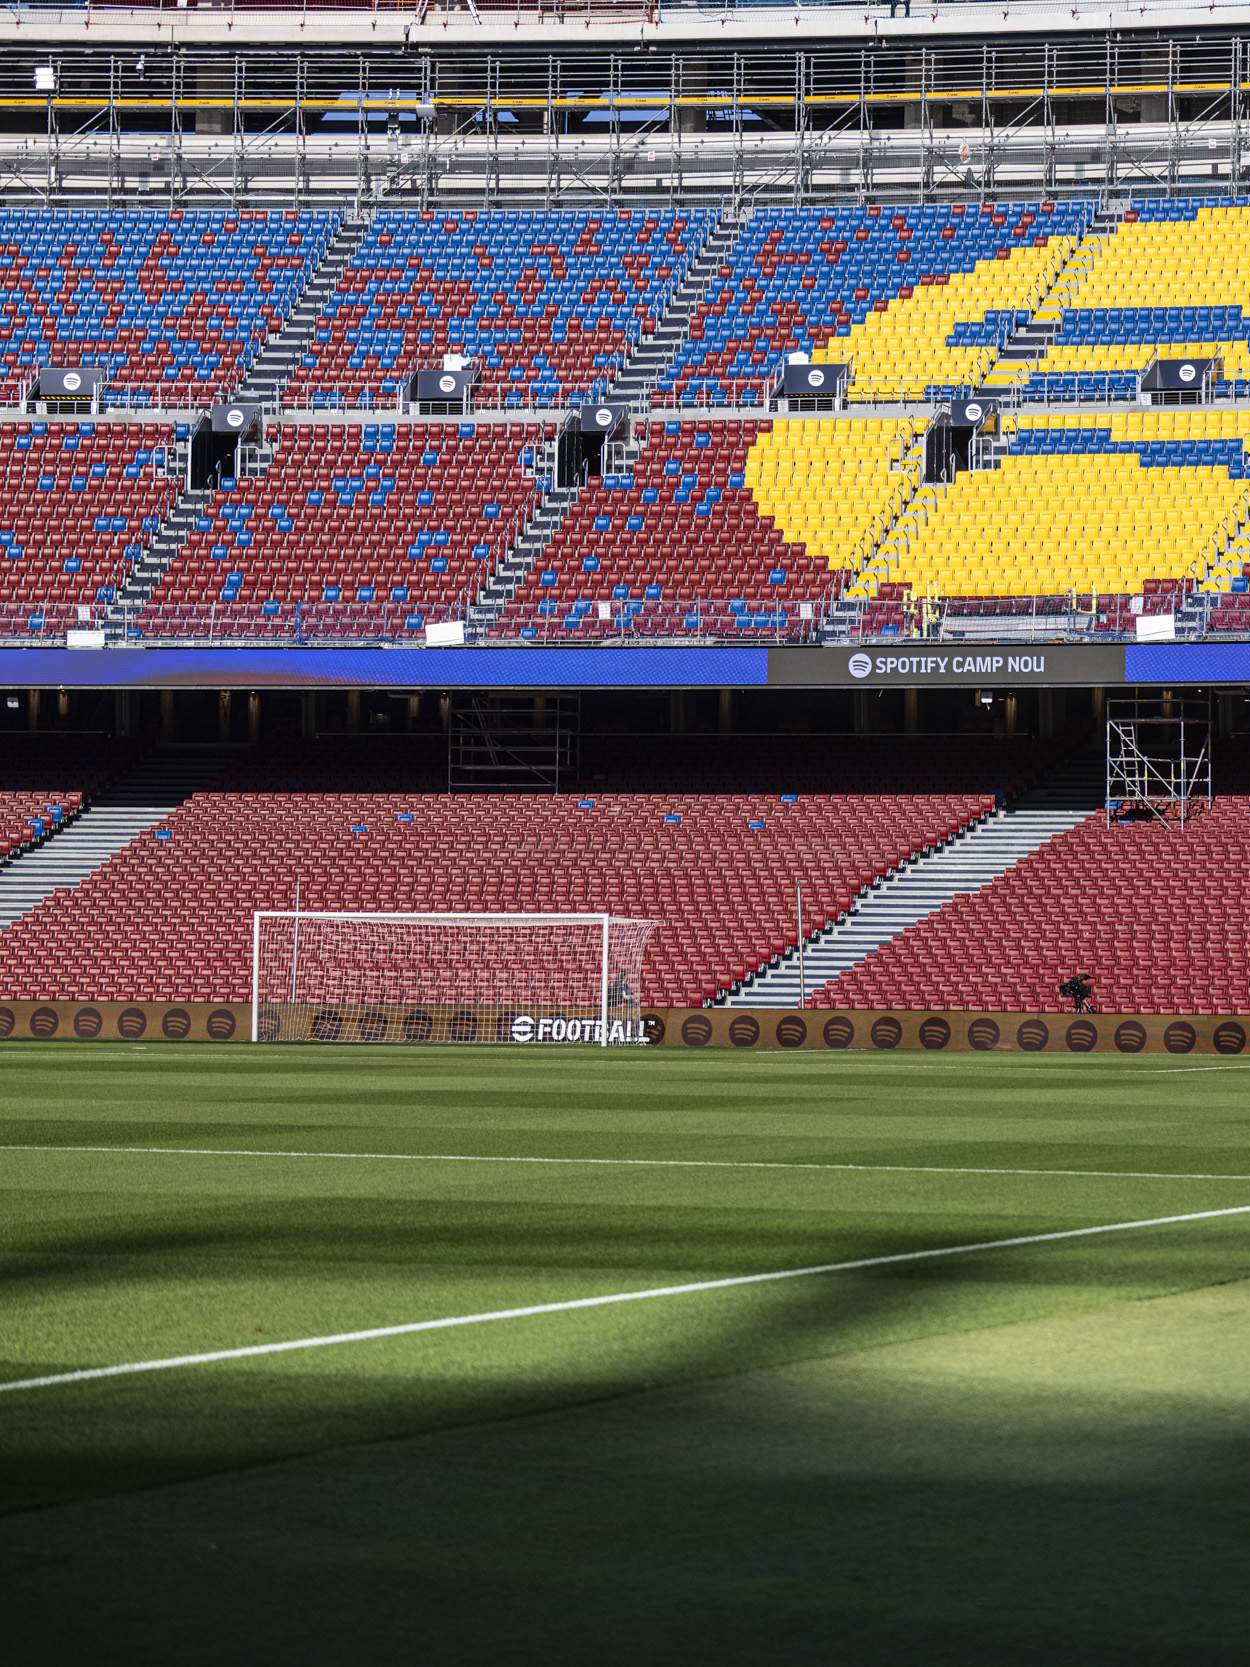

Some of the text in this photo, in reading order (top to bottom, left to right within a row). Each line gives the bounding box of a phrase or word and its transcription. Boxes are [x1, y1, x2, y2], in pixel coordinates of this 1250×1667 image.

[875, 656, 1045, 674] SPOTIFY CAMP NOU
